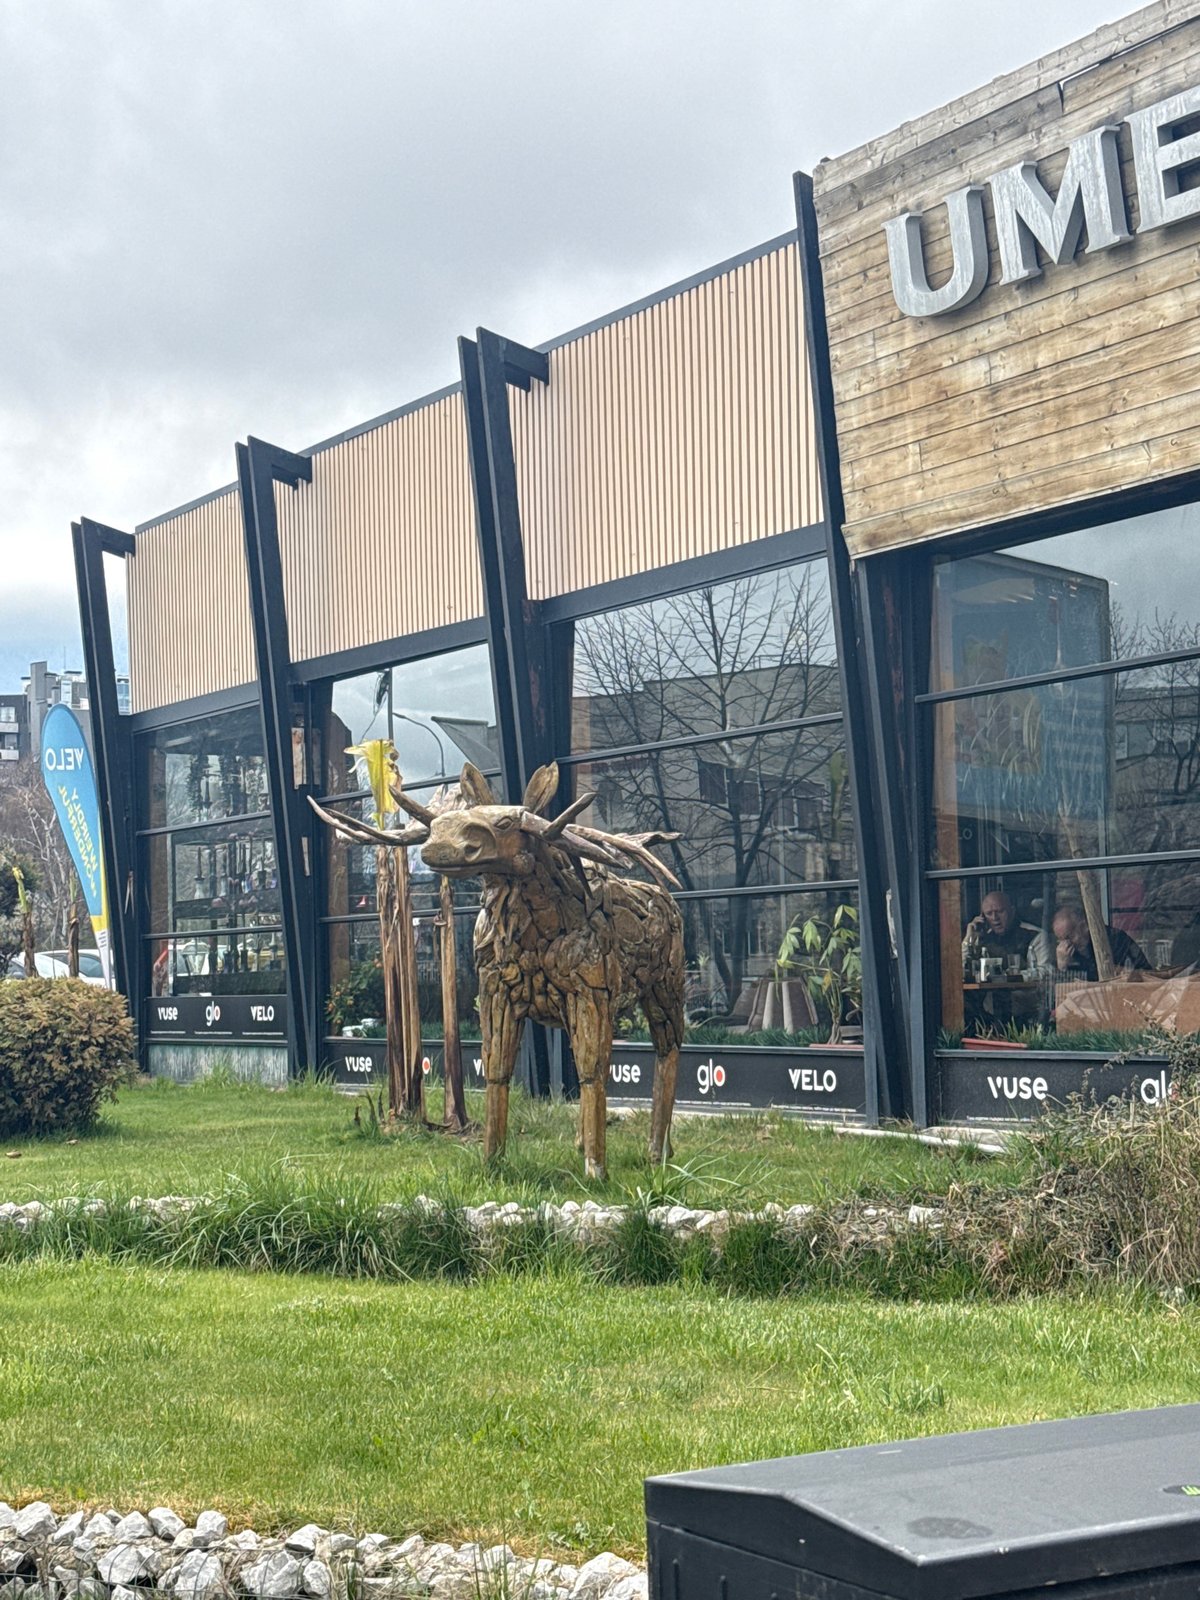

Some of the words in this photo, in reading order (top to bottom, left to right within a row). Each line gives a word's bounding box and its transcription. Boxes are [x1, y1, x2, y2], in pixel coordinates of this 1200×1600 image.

[882, 86, 1200, 317] UME
[157, 1006, 179, 1021] vuse
[205, 1000, 221, 1027] glo
[250, 1005, 275, 1022] VELO
[344, 1055, 373, 1074] vuse
[696, 1058, 726, 1095] glo
[787, 1068, 837, 1093] VELO
[986, 1076, 1049, 1101] vuse
